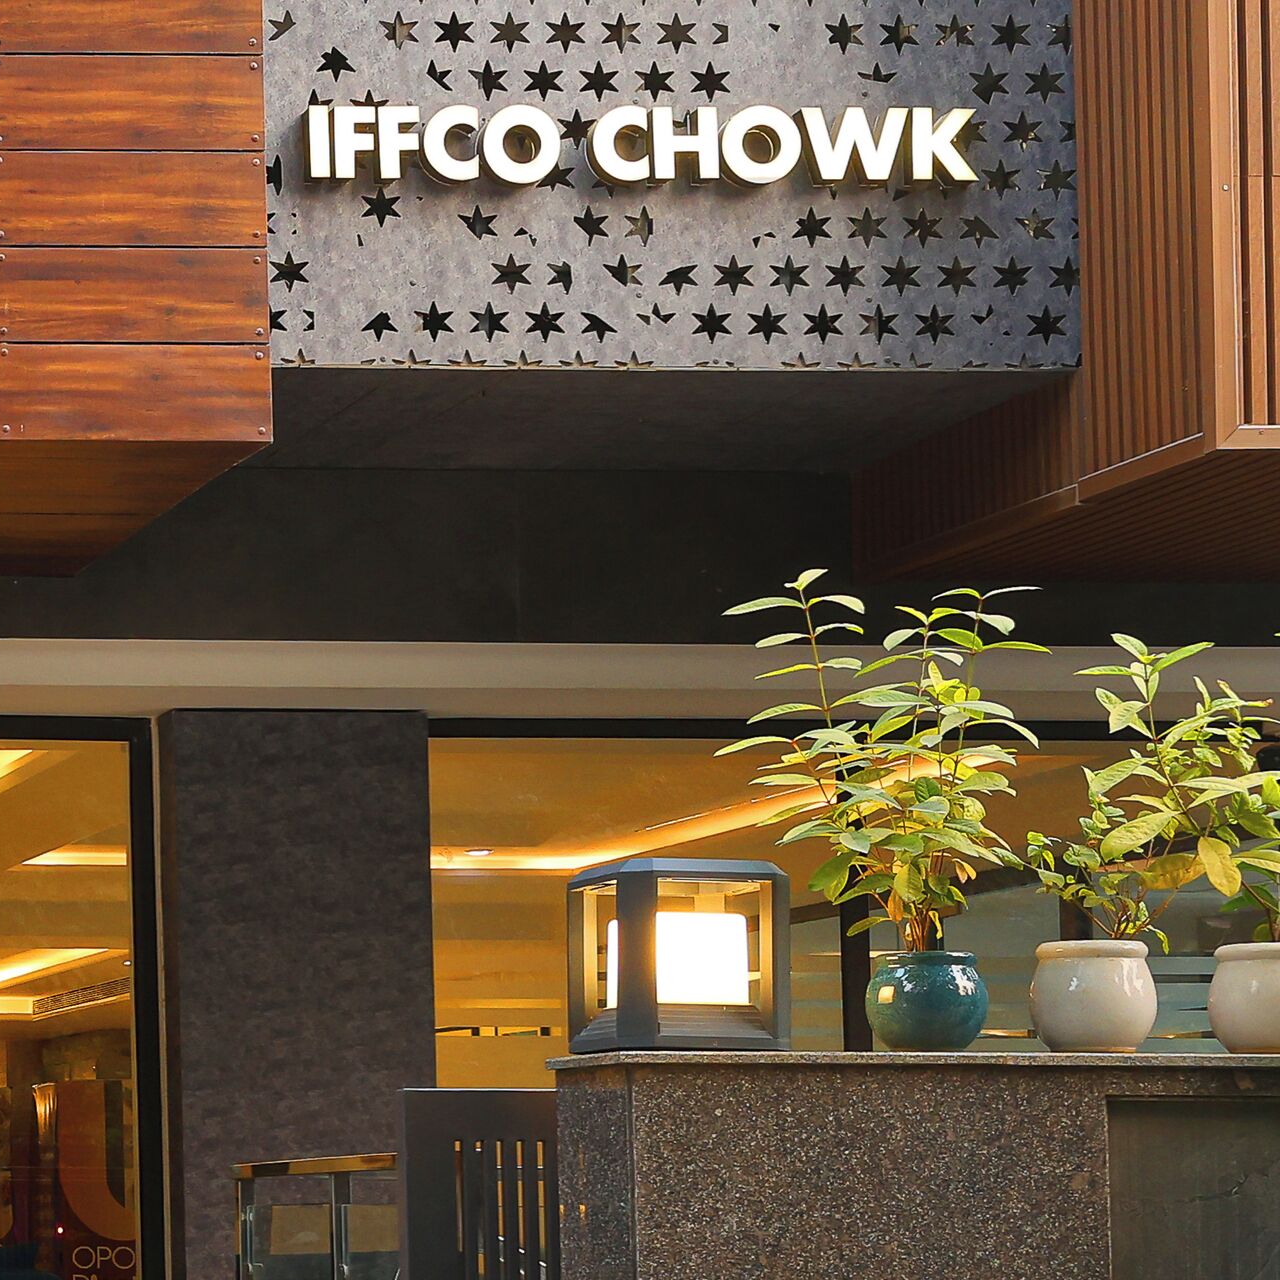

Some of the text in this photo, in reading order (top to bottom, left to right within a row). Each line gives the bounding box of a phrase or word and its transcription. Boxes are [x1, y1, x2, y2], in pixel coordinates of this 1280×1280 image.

[308, 103, 980, 185] IFFCO CHOWK
[71, 1246, 136, 1270] OPO
